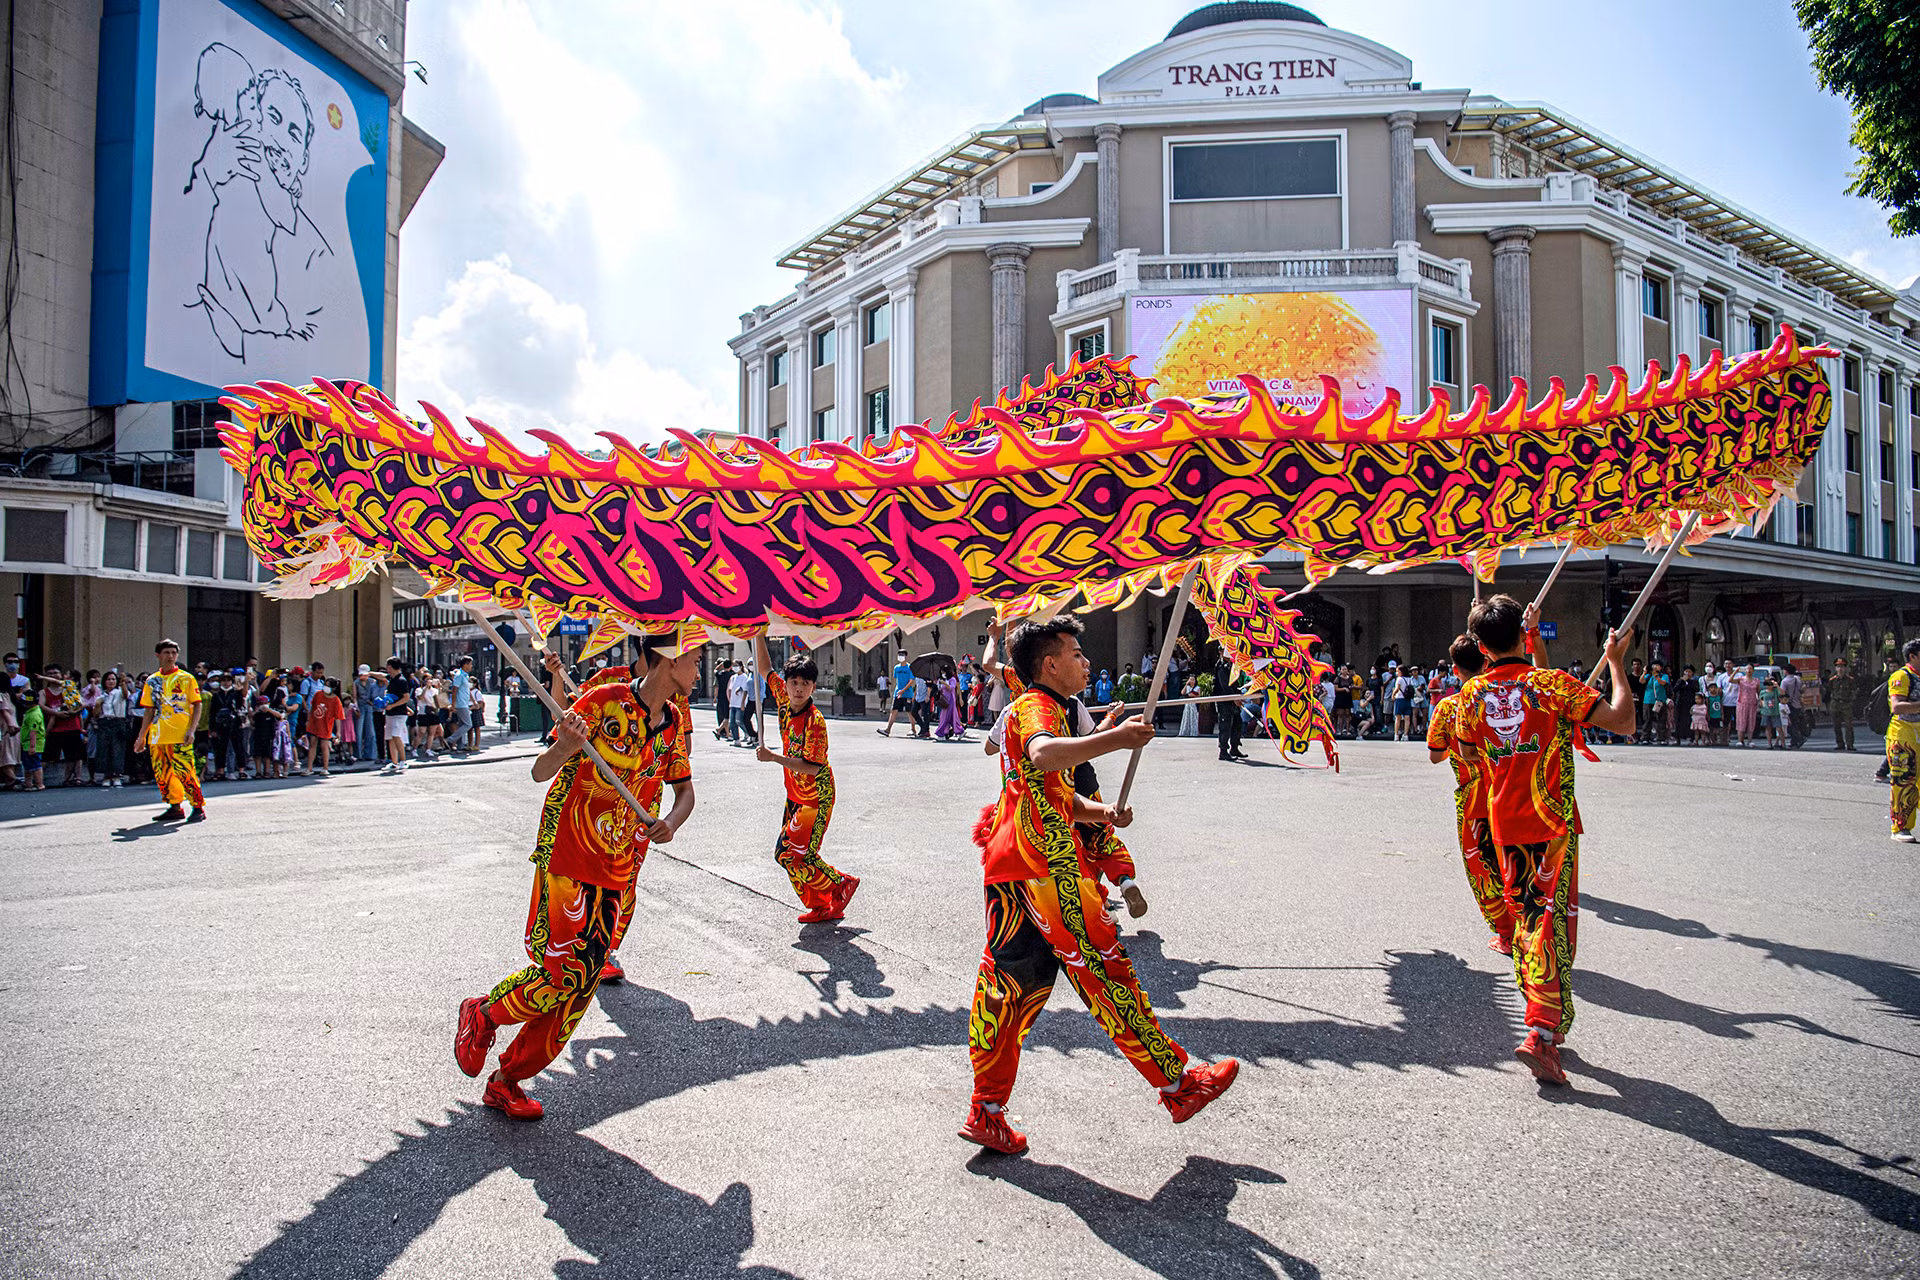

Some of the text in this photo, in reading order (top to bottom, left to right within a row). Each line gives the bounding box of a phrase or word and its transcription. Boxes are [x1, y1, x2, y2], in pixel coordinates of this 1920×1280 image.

[1168, 58, 1337, 86] TRANG TIEN
[1225, 84, 1280, 97] PLAZA
[1136, 299, 1172, 309] POND'S
[1208, 379, 1292, 391] VITAM C &
